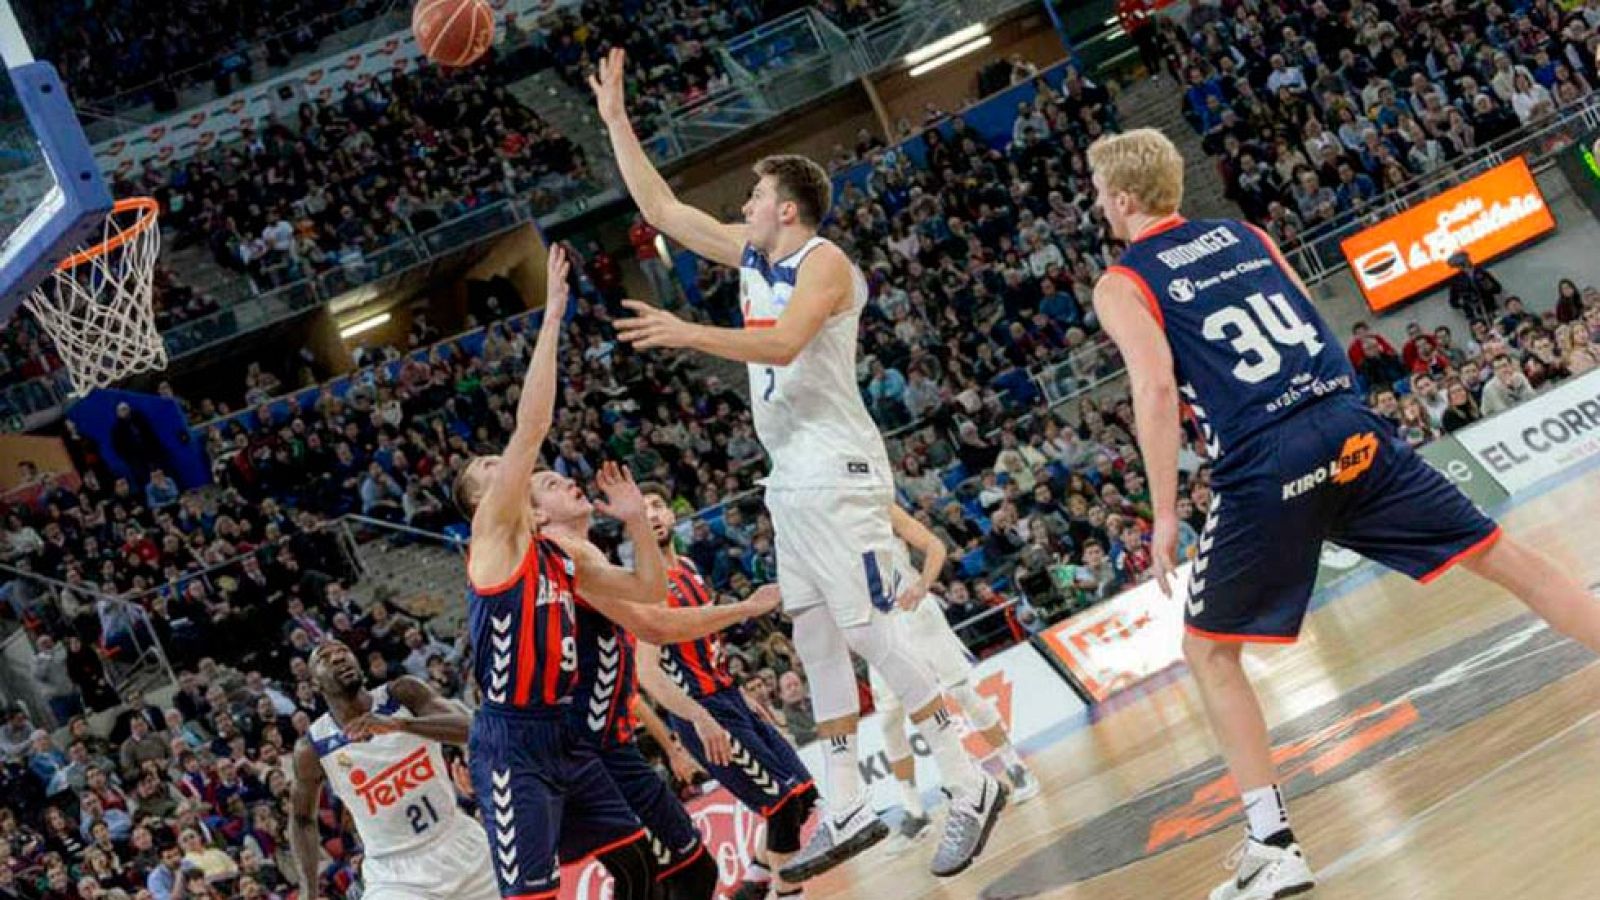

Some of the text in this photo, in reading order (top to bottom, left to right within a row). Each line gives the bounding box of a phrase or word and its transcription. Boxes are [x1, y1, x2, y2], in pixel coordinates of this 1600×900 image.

[1202, 292, 1325, 383] 34
[1480, 441, 1529, 474] EL
[561, 636, 577, 672] 9
[355, 746, 434, 815] Teka
[406, 796, 439, 834] 21
